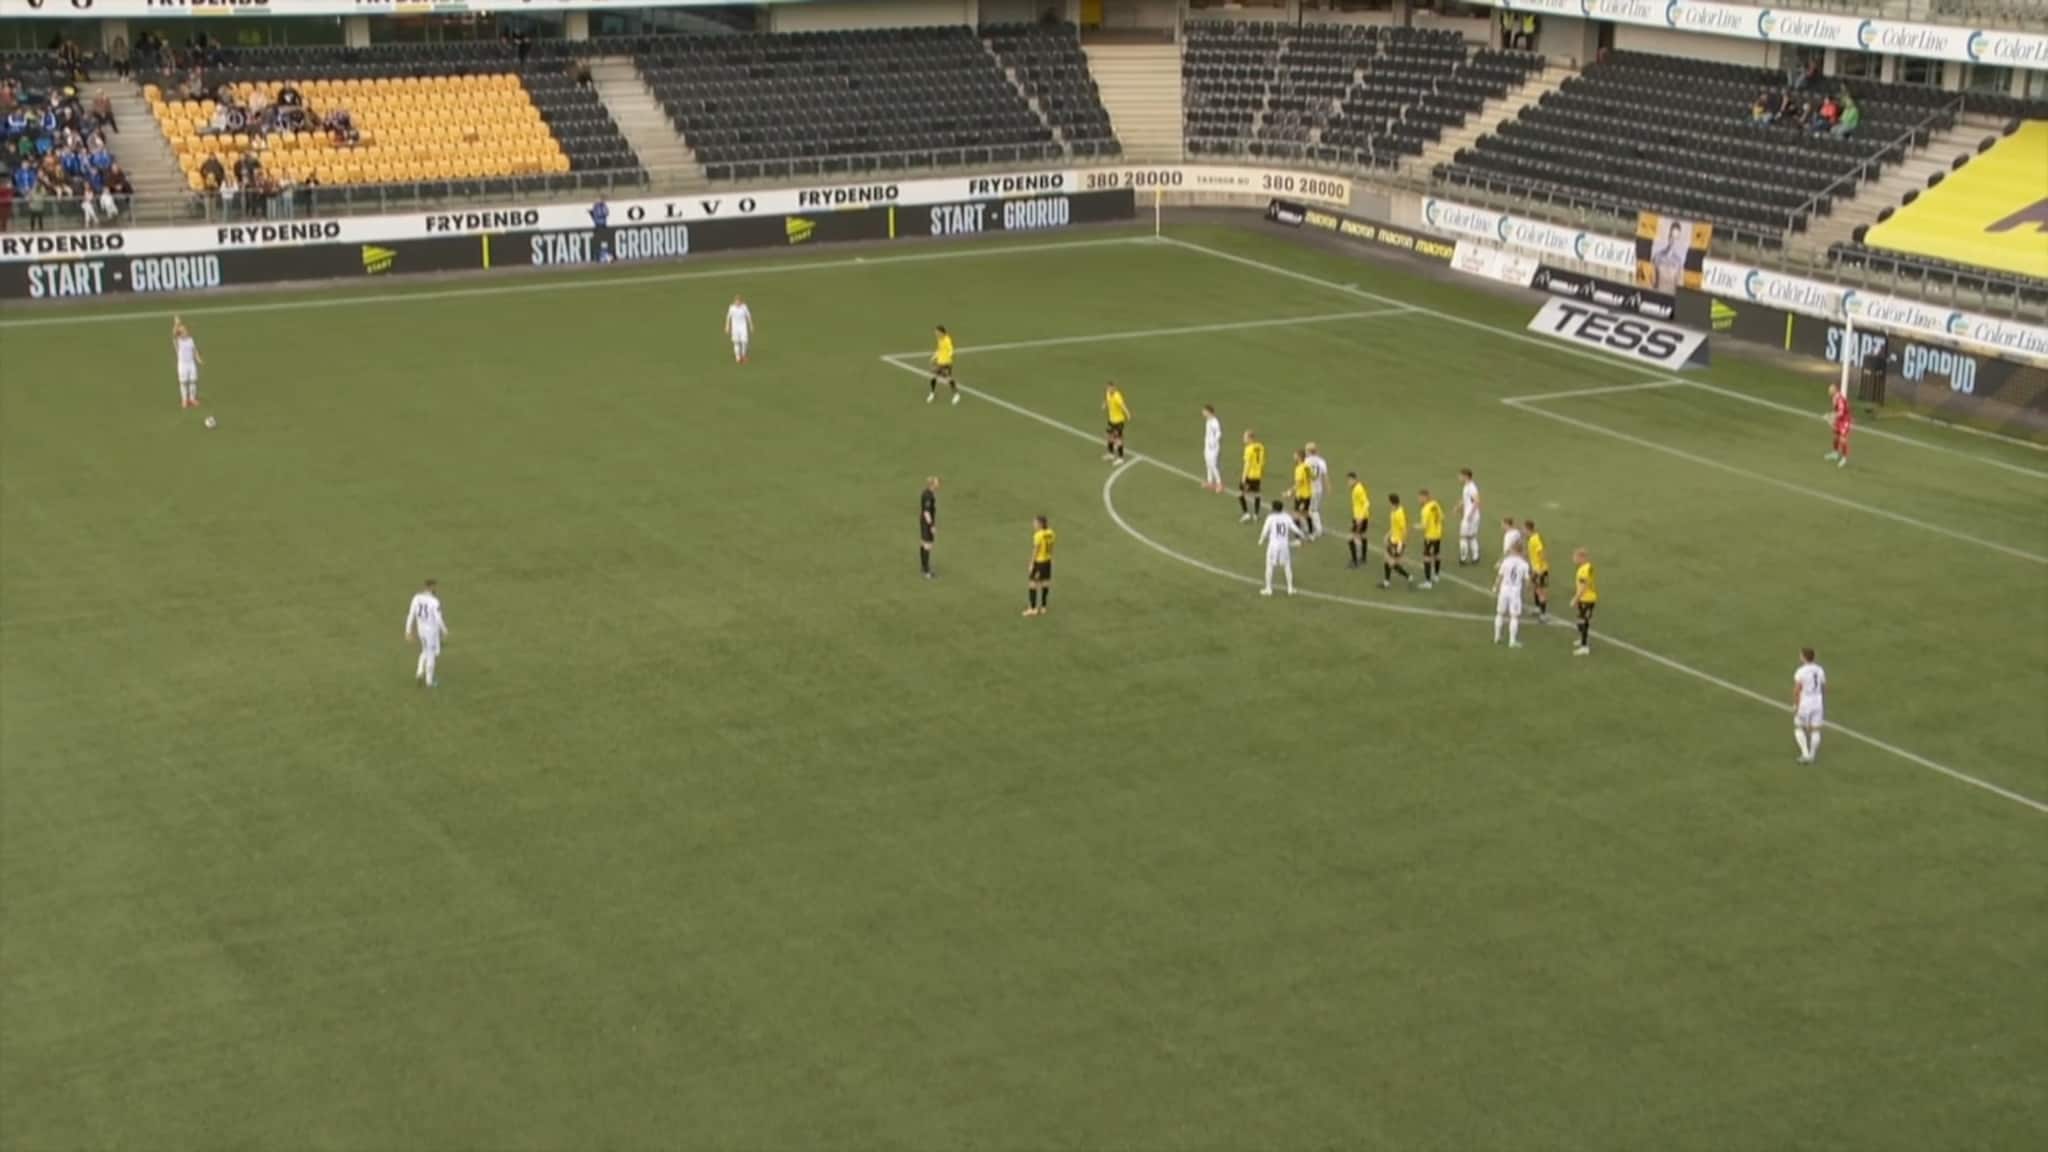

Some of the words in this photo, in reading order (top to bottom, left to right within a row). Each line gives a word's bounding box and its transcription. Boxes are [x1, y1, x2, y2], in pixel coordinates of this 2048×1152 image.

[1087, 173, 1119, 189] 380
[1124, 171, 1183, 187] 28000
[1263, 174, 1294, 192] 380
[1299, 177, 1345, 200] 28000
[931, 204, 987, 235] START
[1004, 197, 1069, 230] GRORUD
[531, 231, 595, 266] START
[614, 224, 690, 260] GRORUD
[28, 261, 104, 298] START
[130, 254, 221, 292] GRORUD
[1554, 303, 1685, 359] TESS
